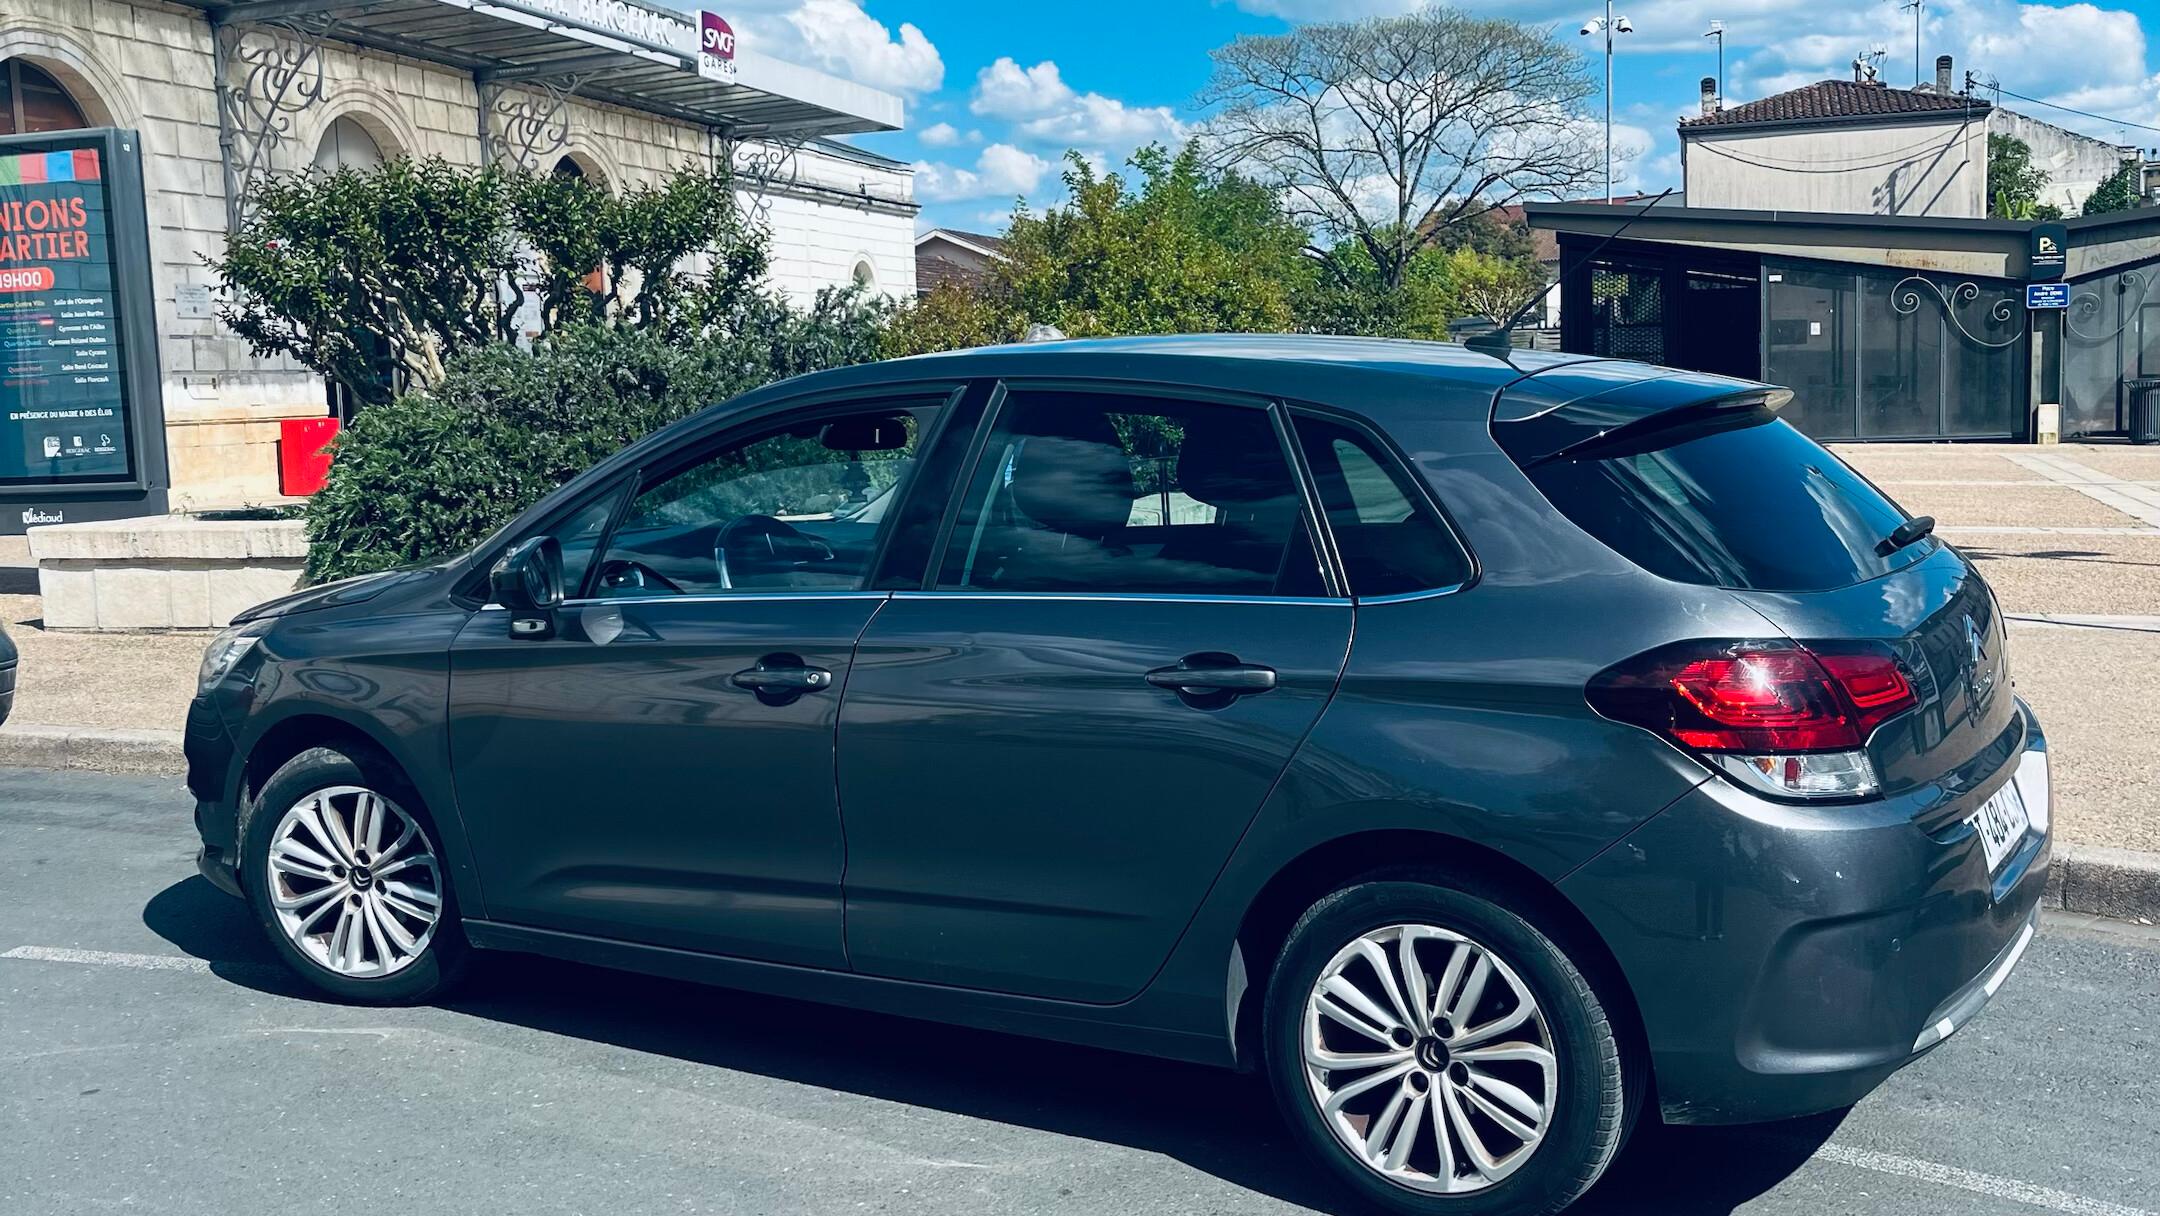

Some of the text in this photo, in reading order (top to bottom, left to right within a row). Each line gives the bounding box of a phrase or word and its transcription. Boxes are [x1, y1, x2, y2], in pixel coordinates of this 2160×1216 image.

[703, 28, 733, 53] SNCF
[0, 230, 90, 262] ARTIER
[84, 409, 97, 417] DES
